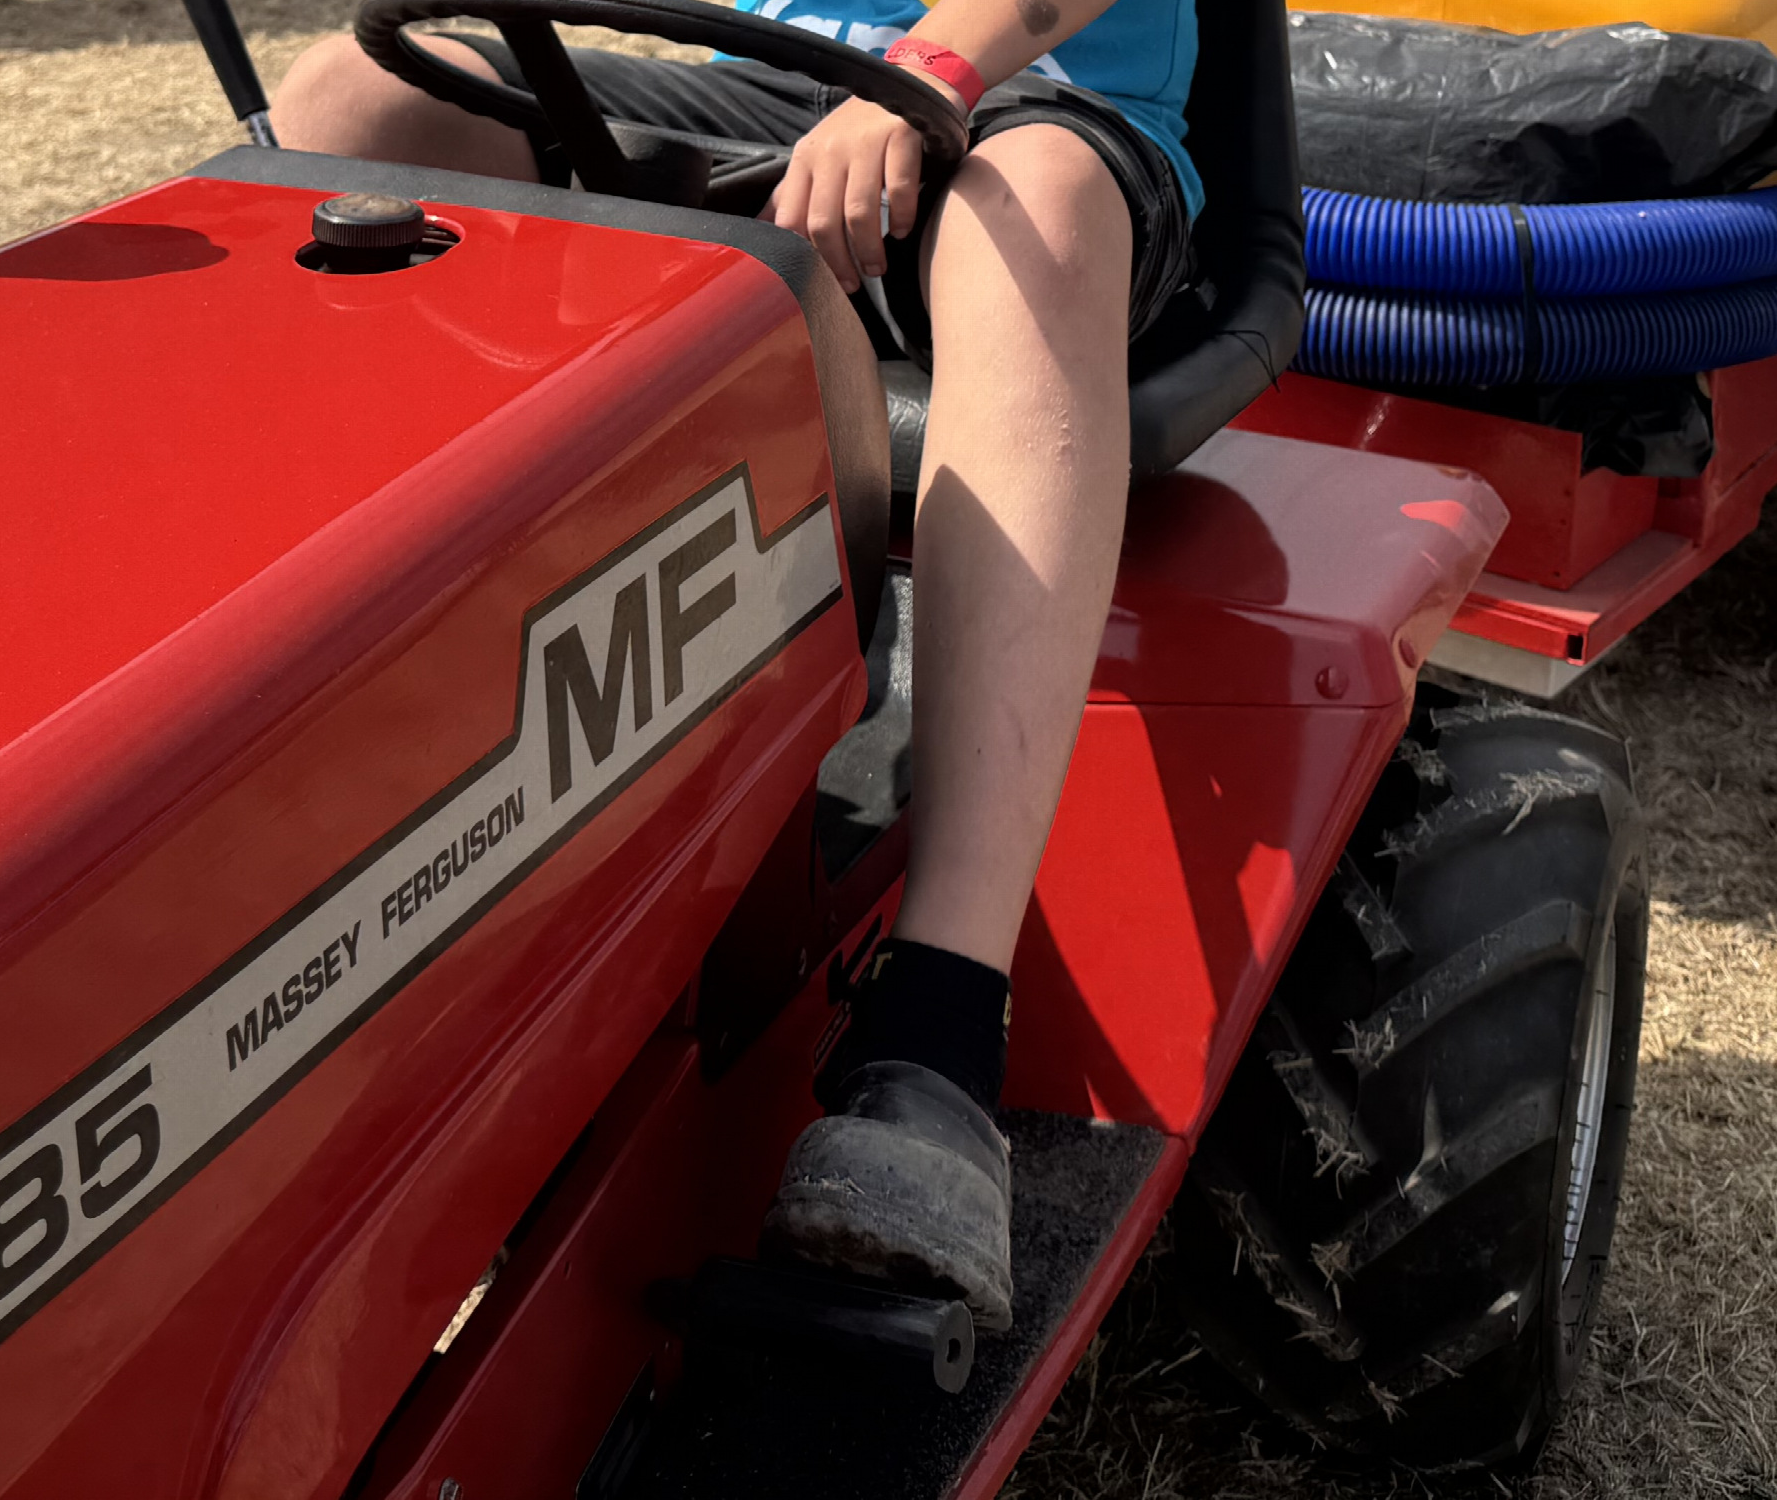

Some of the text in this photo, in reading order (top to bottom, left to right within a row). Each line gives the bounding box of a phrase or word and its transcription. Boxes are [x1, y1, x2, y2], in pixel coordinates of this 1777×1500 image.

[543, 509, 737, 804] MF
[226, 920, 361, 1071] MASSEY
[381, 787, 525, 939] FERGUSON
